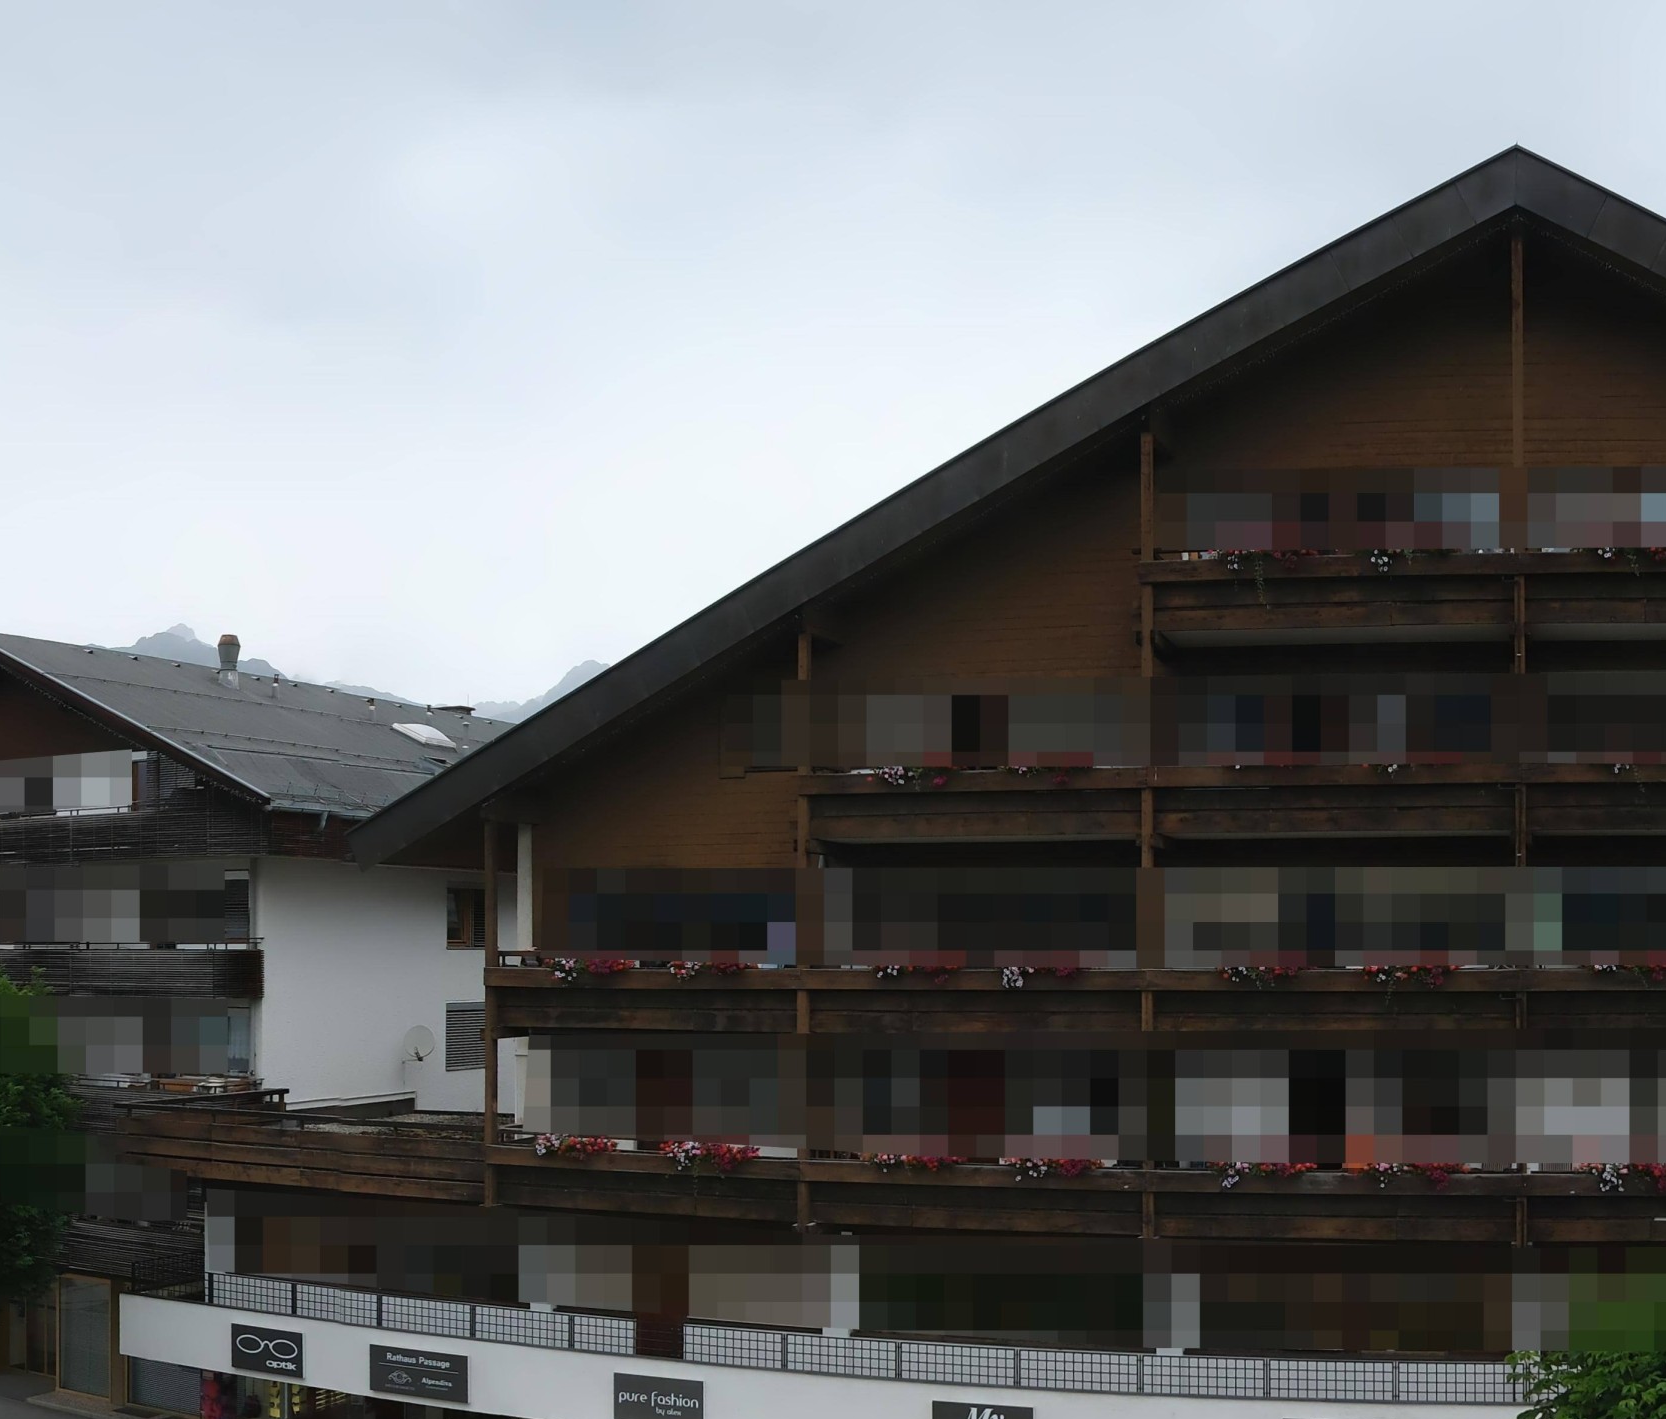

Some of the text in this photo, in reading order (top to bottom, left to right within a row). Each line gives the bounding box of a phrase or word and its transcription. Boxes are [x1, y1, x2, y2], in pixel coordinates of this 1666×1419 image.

[266, 1360, 297, 1371] optik
[386, 1352, 450, 1368] Rathaus Passage
[619, 1391, 699, 1408] pure fashion
[656, 1408, 665, 1417] by
